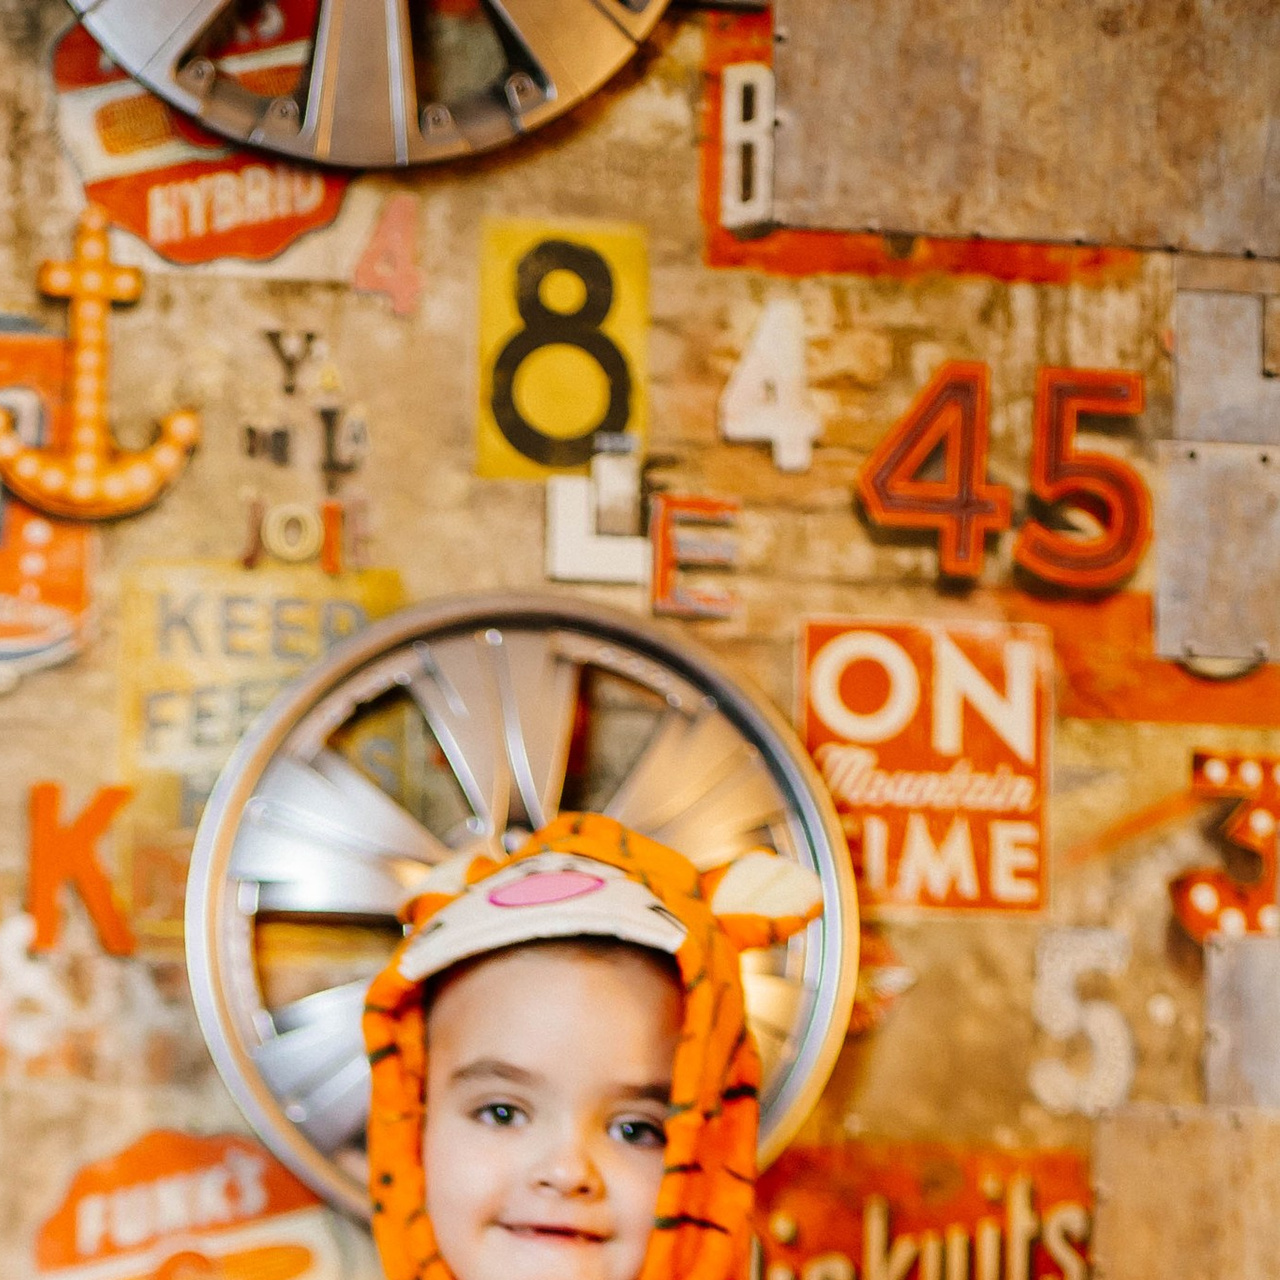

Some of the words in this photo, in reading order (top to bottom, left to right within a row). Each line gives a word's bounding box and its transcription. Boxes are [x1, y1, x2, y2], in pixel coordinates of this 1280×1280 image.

[492, 239, 632, 468] 8
[723, 301, 820, 471] 4
[859, 361, 1153, 594] 45
[808, 629, 1037, 764] ON
[816, 743, 1036, 810] Mountain
[27, 781, 135, 956] K
[846, 812, 1041, 903] IME
[1028, 927, 1136, 1117] 5
